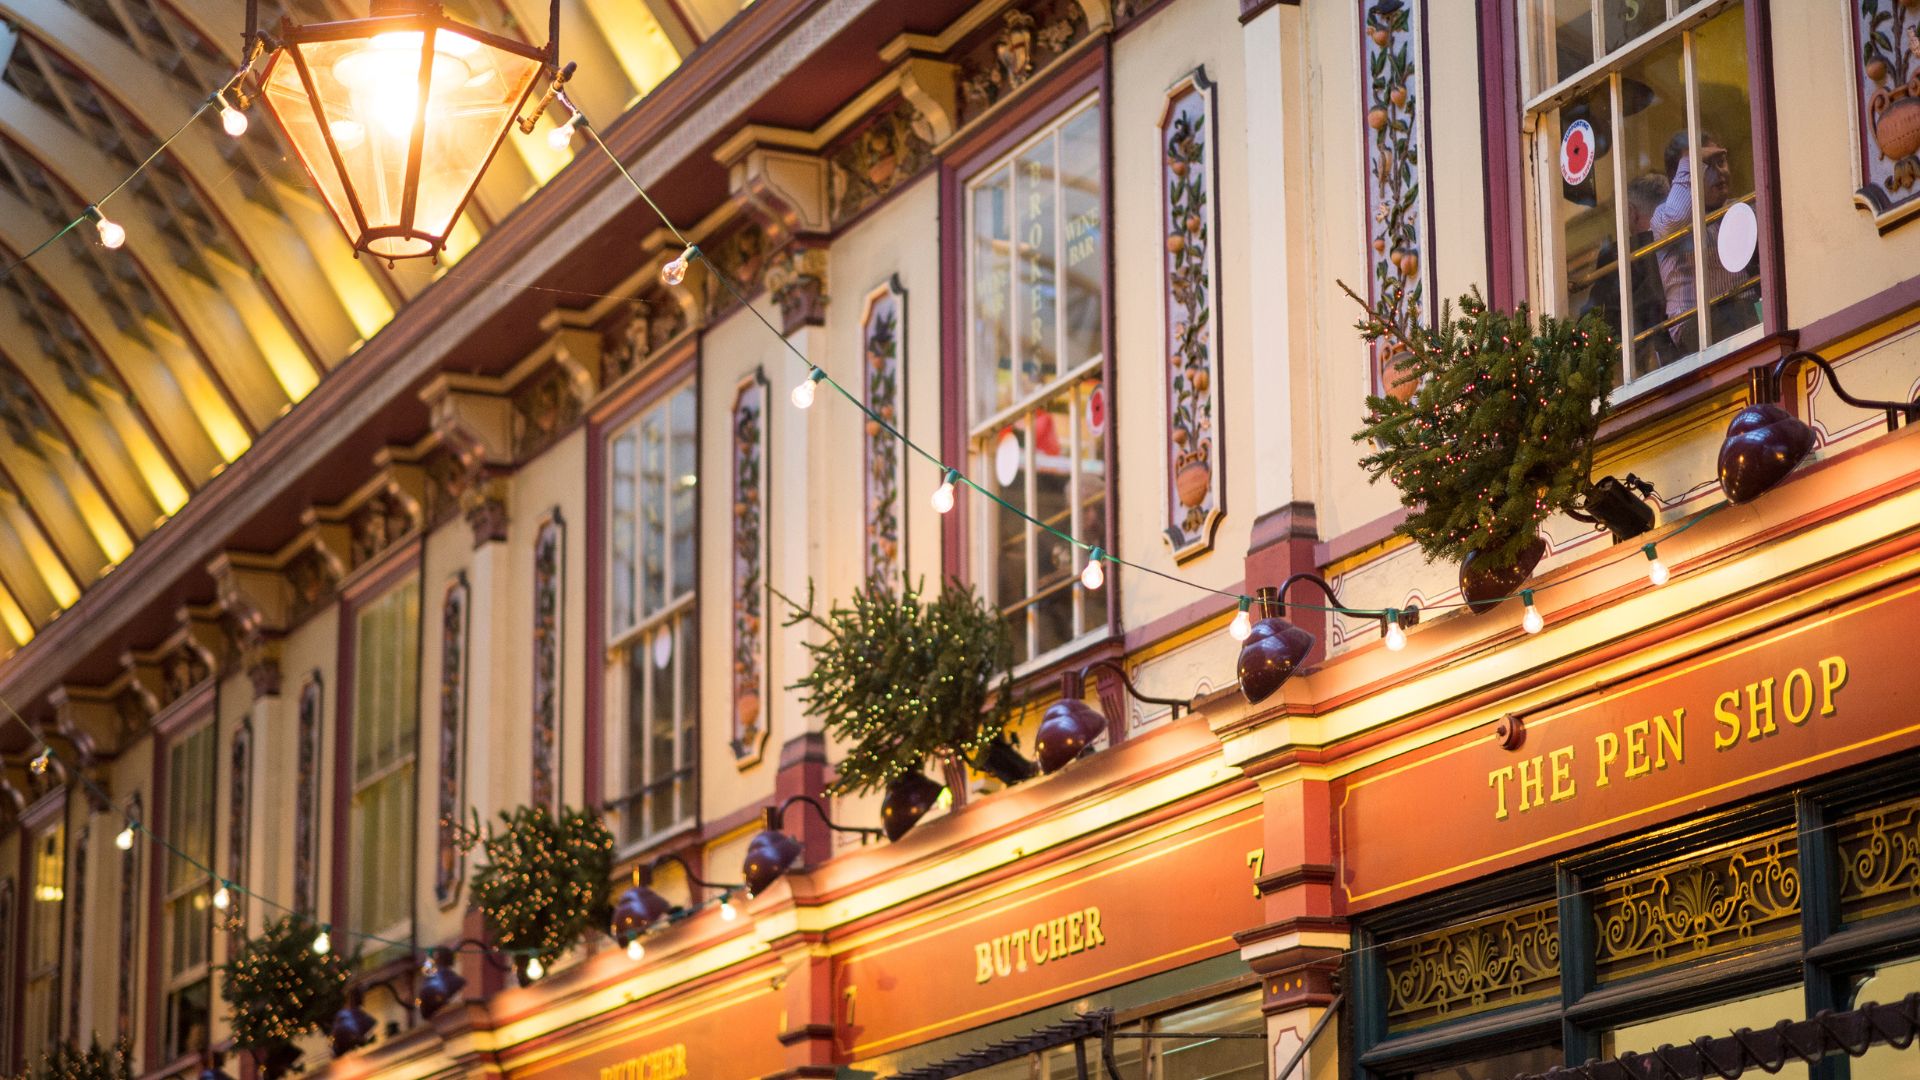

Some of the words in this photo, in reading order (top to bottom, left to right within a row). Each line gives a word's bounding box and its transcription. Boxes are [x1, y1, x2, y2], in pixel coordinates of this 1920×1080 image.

[1069, 235, 1095, 267] BAR
[1488, 744, 1578, 821] THE
[1596, 707, 1688, 789] PEN
[1713, 655, 1849, 752] SHOP
[1246, 847, 1264, 900] 7
[974, 905, 1105, 984] BUTCHER
